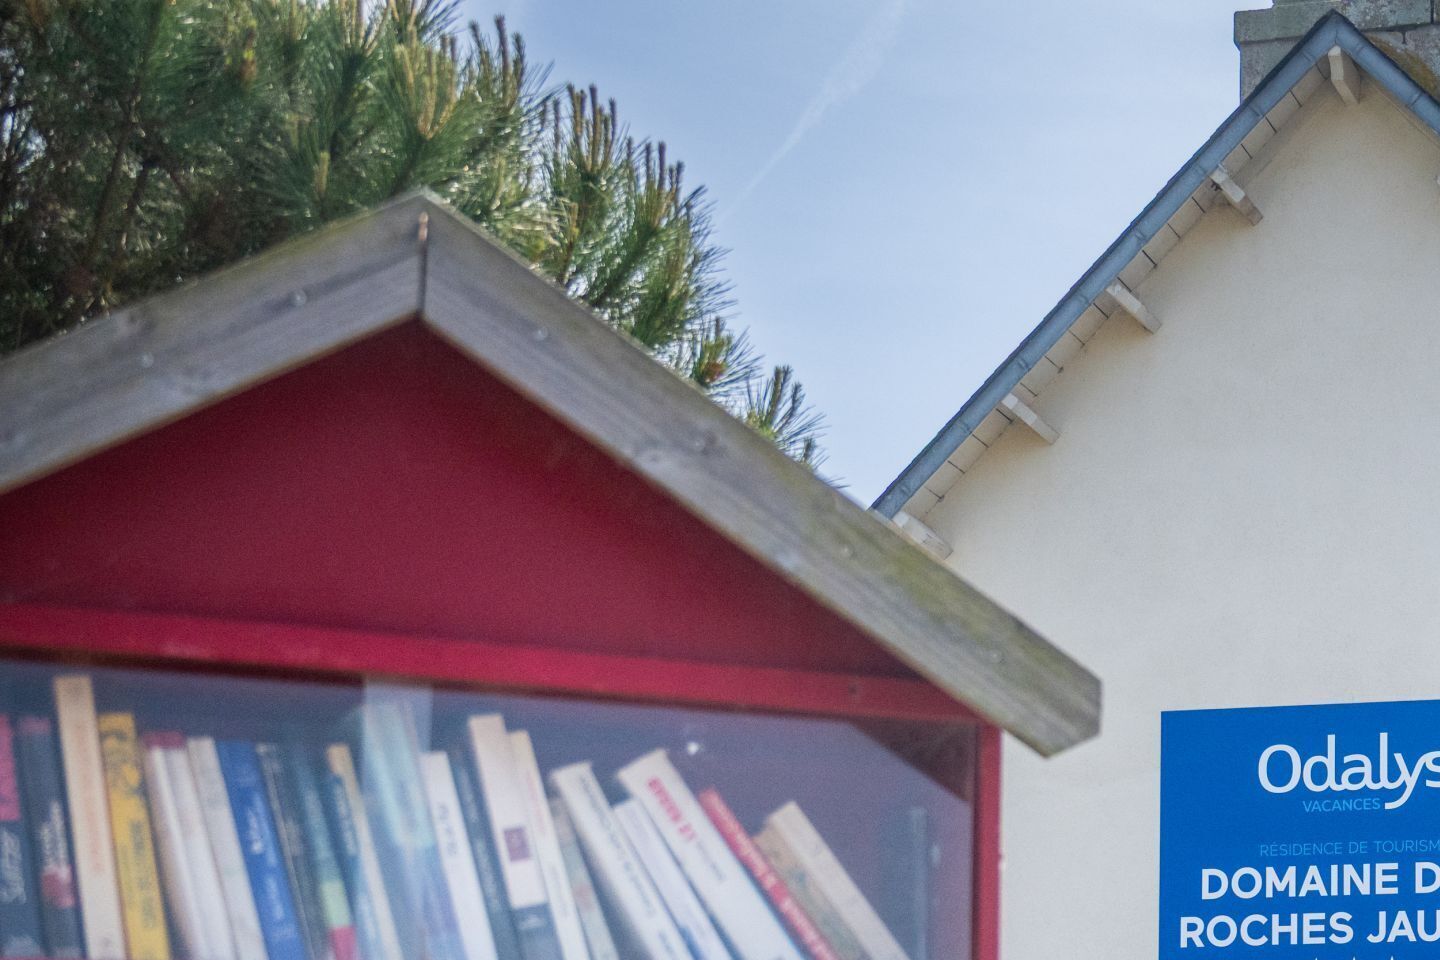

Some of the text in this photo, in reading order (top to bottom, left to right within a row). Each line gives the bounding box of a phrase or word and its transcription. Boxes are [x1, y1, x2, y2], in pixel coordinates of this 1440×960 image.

[1302, 798, 1381, 813] VACANCES
[1260, 841, 1344, 857] RÉSIDENCE
[1349, 841, 1368, 854] DE
[1201, 862, 1399, 900] DOMAINE
[1180, 911, 1354, 948] ROCHES
